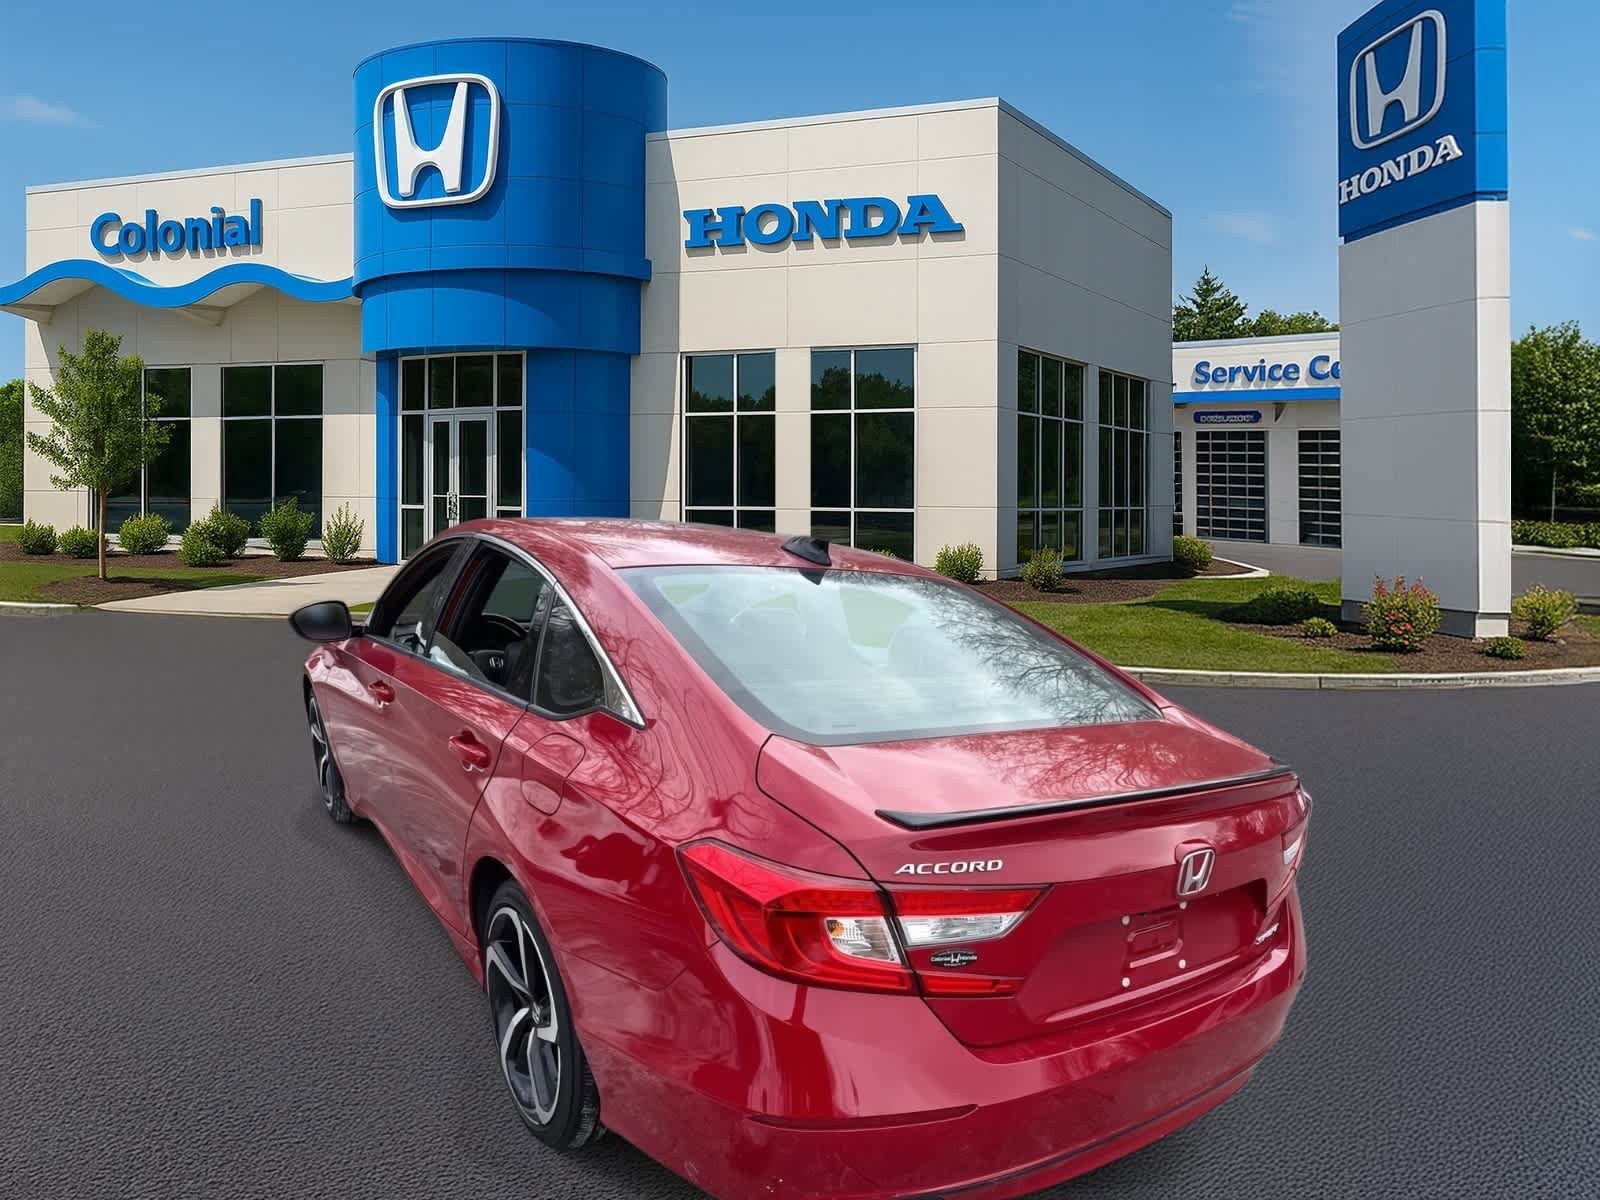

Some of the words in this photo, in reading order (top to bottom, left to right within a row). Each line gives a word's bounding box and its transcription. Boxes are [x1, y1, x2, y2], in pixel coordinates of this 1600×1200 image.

[1339, 134, 1463, 204] HONDA
[90, 198, 263, 256] Colonial
[683, 194, 966, 249] HONDA
[1194, 358, 1300, 384] Service
[894, 859, 1003, 875] ACCORD
